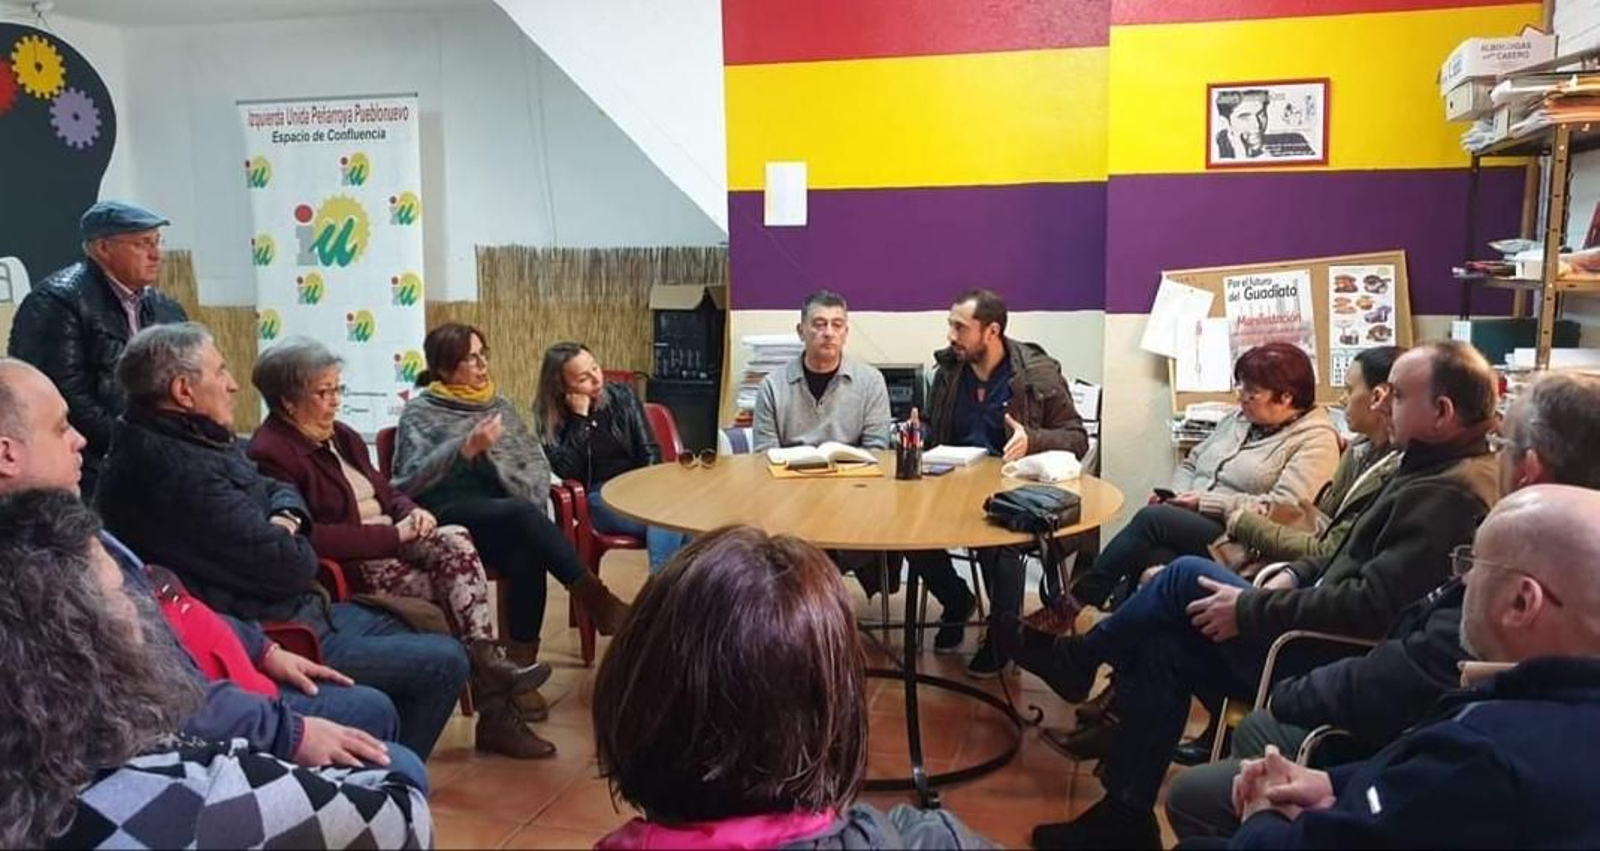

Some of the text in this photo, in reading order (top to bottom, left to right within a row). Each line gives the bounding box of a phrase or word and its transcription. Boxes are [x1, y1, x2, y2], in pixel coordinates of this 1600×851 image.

[287, 107, 309, 125] Unida
[355, 103, 409, 123] Pueblonuevo
[272, 126, 386, 145] Espacio de Confluencia
[1228, 279, 1240, 289] Por
[1228, 284, 1297, 302] del Guadiato
